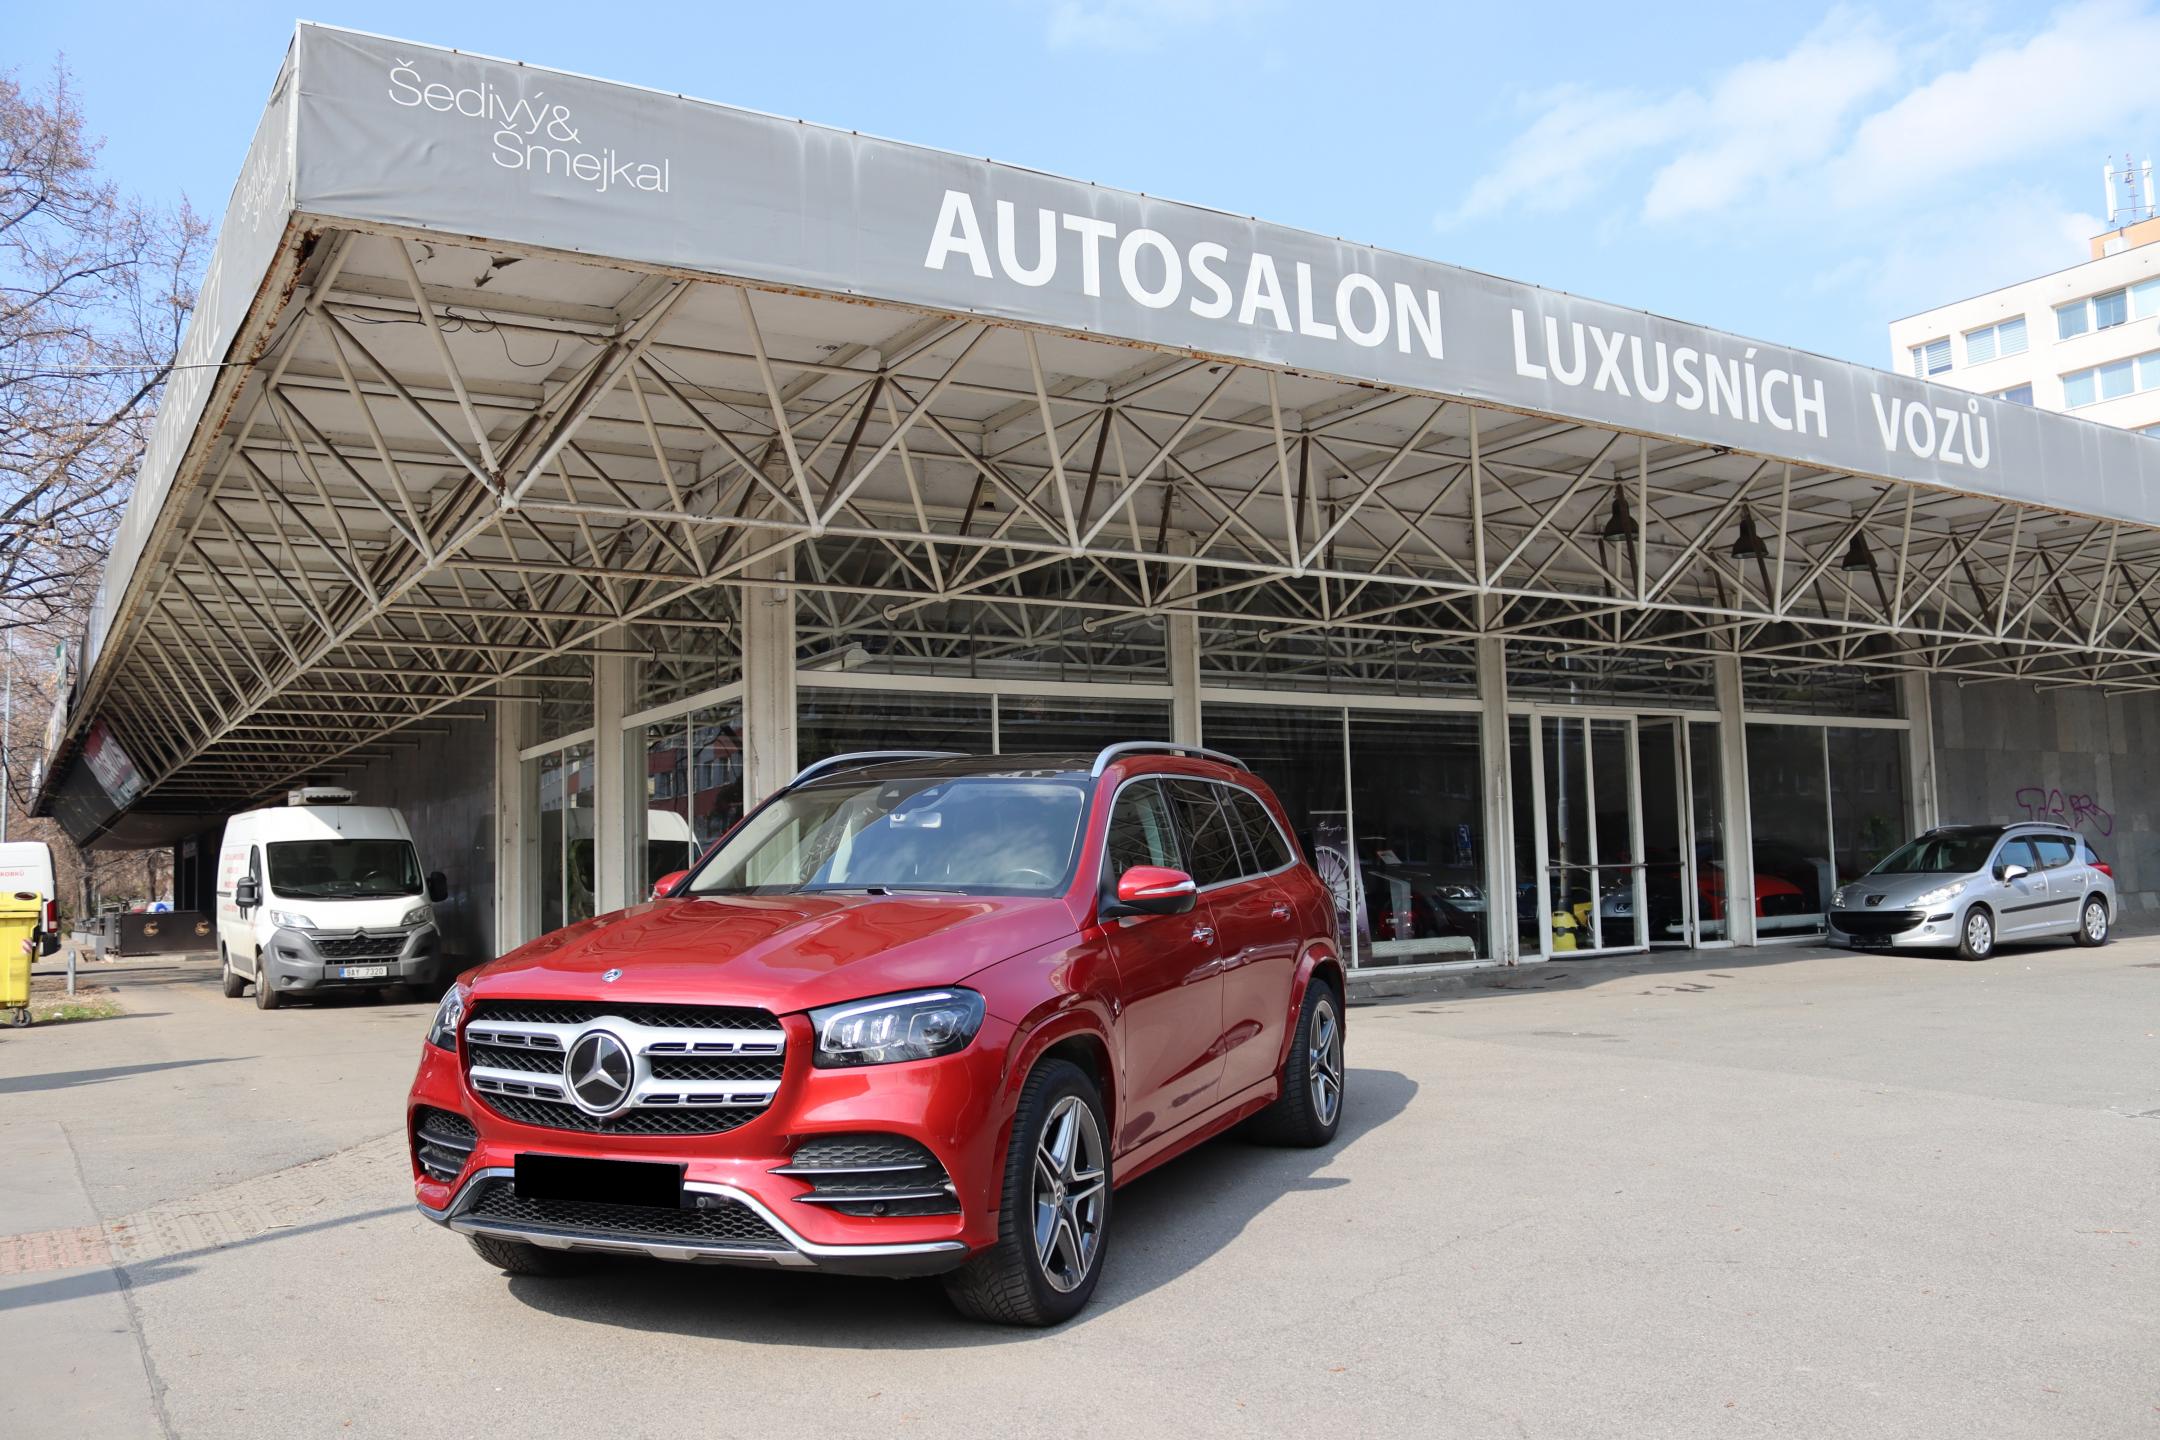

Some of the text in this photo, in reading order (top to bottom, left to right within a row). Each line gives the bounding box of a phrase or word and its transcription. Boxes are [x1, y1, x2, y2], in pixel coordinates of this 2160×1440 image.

[388, 57, 582, 145] Šedivý&
[492, 120, 670, 193] Šmejkal
[923, 188, 1991, 469] AUTOSALON LUXUSNÍCH VOZŮ
